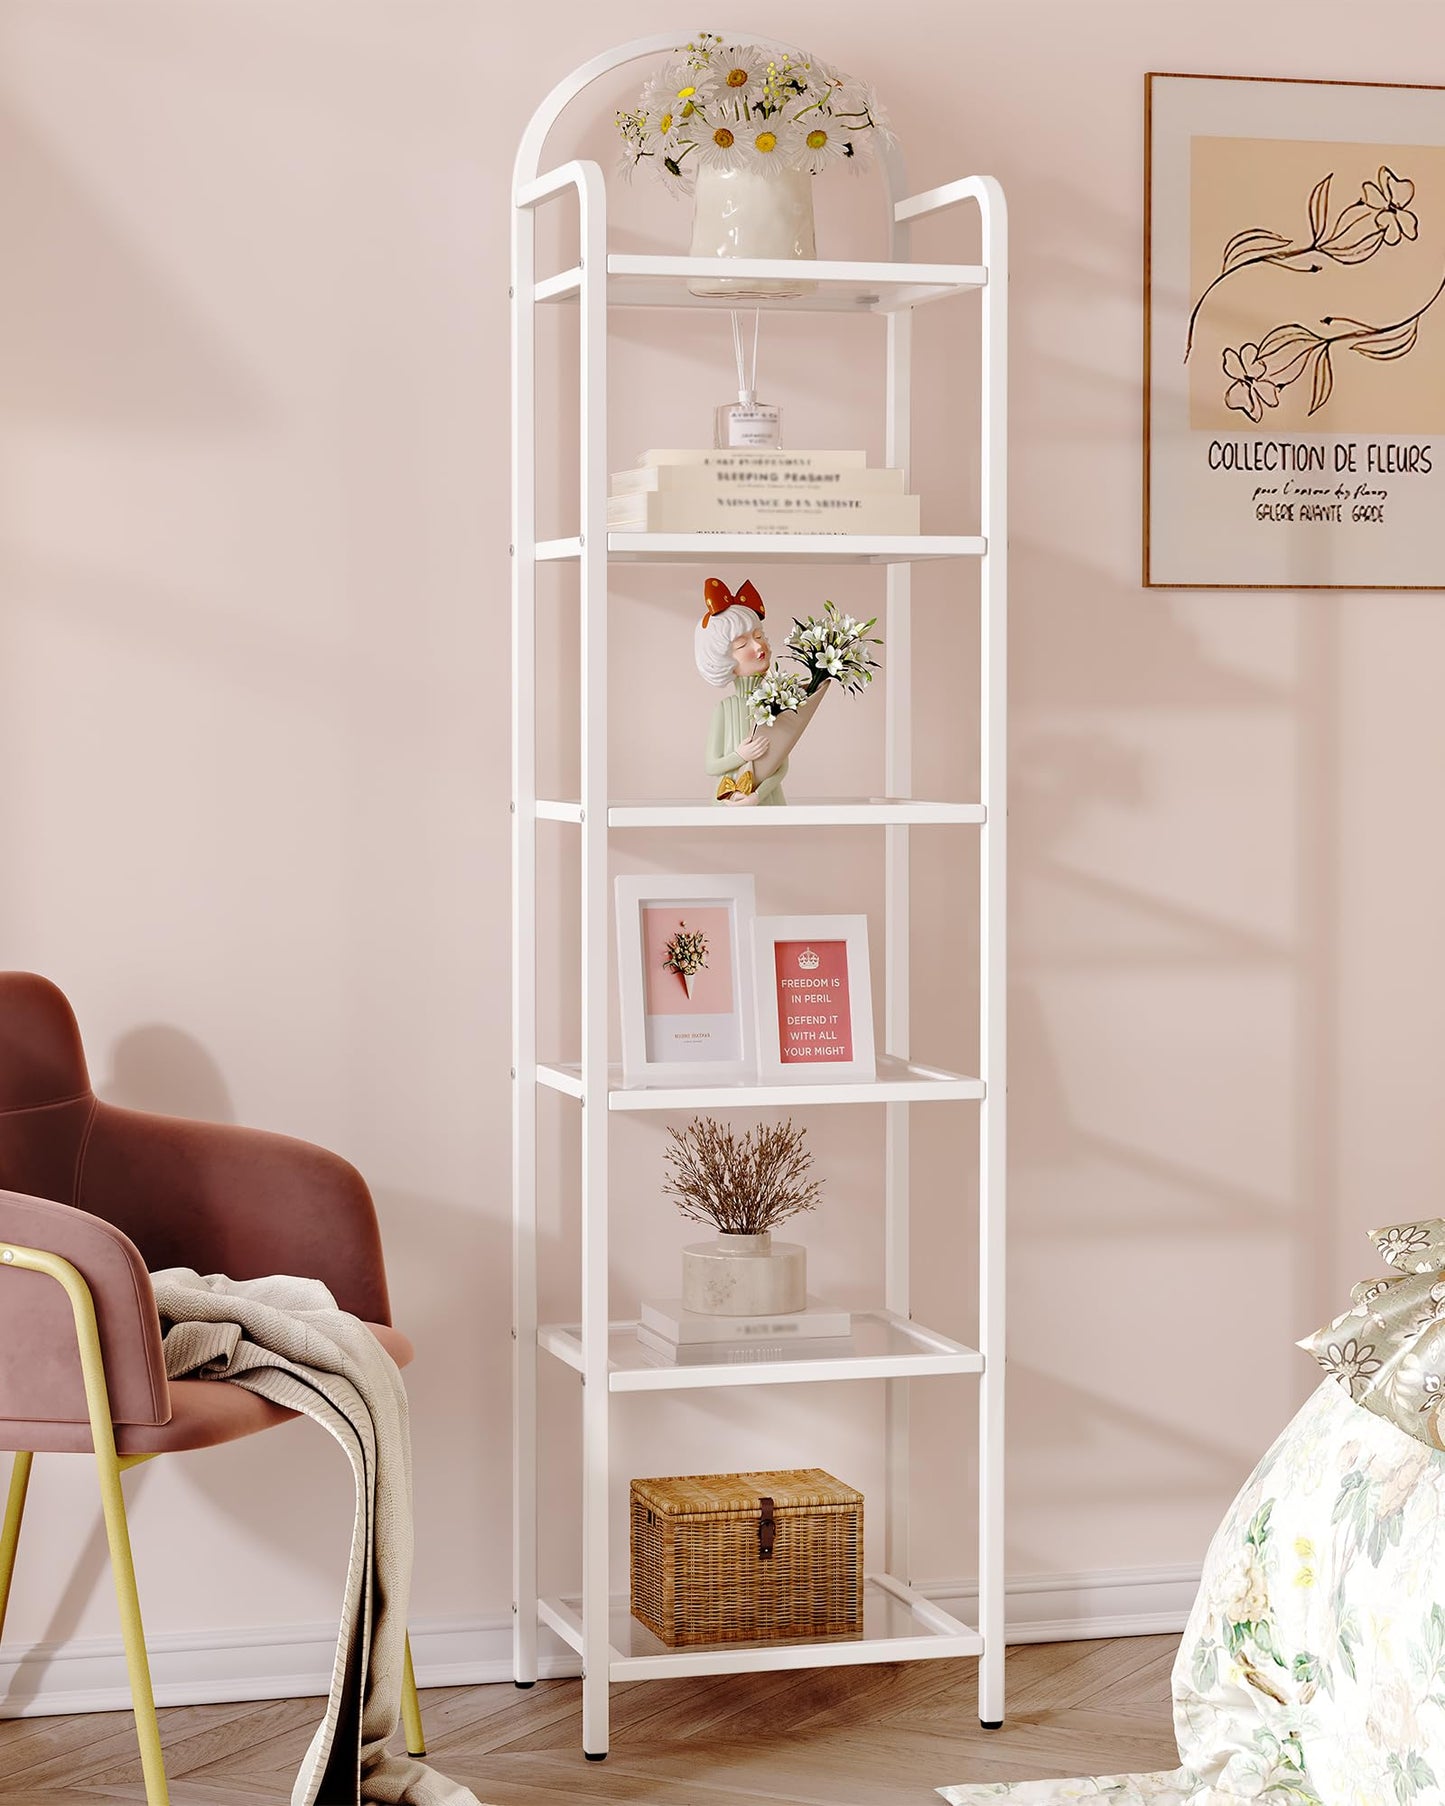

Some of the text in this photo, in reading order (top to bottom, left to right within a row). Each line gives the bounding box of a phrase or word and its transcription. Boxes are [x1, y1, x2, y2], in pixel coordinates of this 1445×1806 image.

[1208, 440, 1433, 474] COLLECTION DE FLEURS
[717, 472, 840, 482] SLEEPING PEASANT
[781, 978, 840, 988] FREEDOM IS
[791, 994, 832, 1003] IN PERIL
[787, 1015, 838, 1025] DEFEND IT
[790, 1030, 837, 1040] WITH ALL
[784, 1046, 845, 1057] YOUR MIGHT
